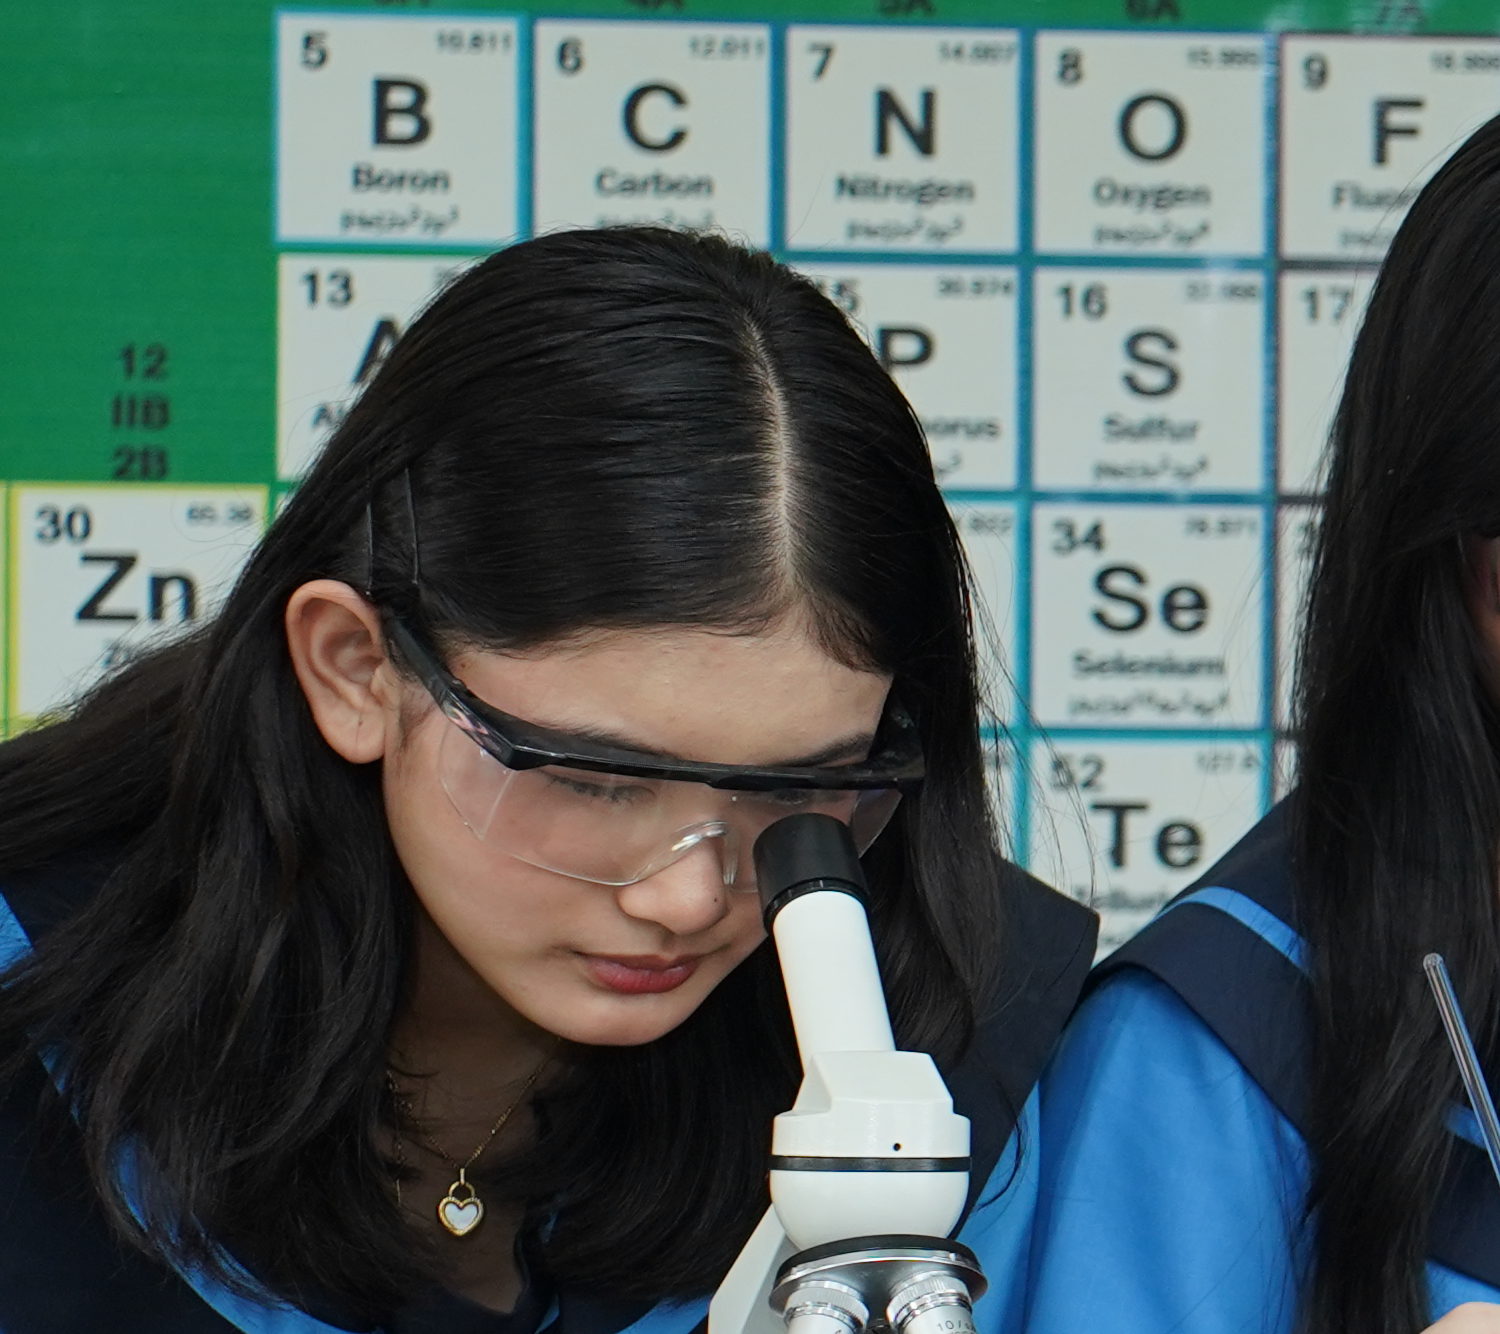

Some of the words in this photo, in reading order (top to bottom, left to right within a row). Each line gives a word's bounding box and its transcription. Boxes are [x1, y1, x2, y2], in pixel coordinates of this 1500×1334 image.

[302, 32, 328, 69] 5
[557, 37, 584, 74] 6
[808, 43, 835, 81] 7
[1058, 48, 1083, 86] 8
[1303, 54, 1329, 90] 9
[374, 78, 432, 146] B
[623, 82, 688, 153] C
[875, 90, 935, 157] N
[1118, 94, 1189, 162] O
[1373, 99, 1425, 165] F
[353, 165, 450, 191] Boron
[597, 169, 714, 198] Carbon
[837, 174, 976, 206] Nitrogen
[1094, 178, 1210, 212] Oxygen
[303, 270, 352, 307] 13
[1060, 284, 1107, 320] 16
[1304, 286, 1351, 322] 17
[120, 343, 168, 378] 12
[877, 327, 934, 371] P
[1122, 330, 1180, 399] S
[111, 395, 169, 429] IIB
[1104, 415, 1198, 441] Sulfur
[112, 445, 169, 479] 2B
[36, 505, 91, 544] 30
[1052, 519, 1105, 556] 34
[76, 553, 197, 621] Zn
[1095, 564, 1209, 633] Se
[1074, 651, 1224, 680] Selenium
[1052, 754, 1104, 792] 52
[1092, 802, 1204, 869] Te
